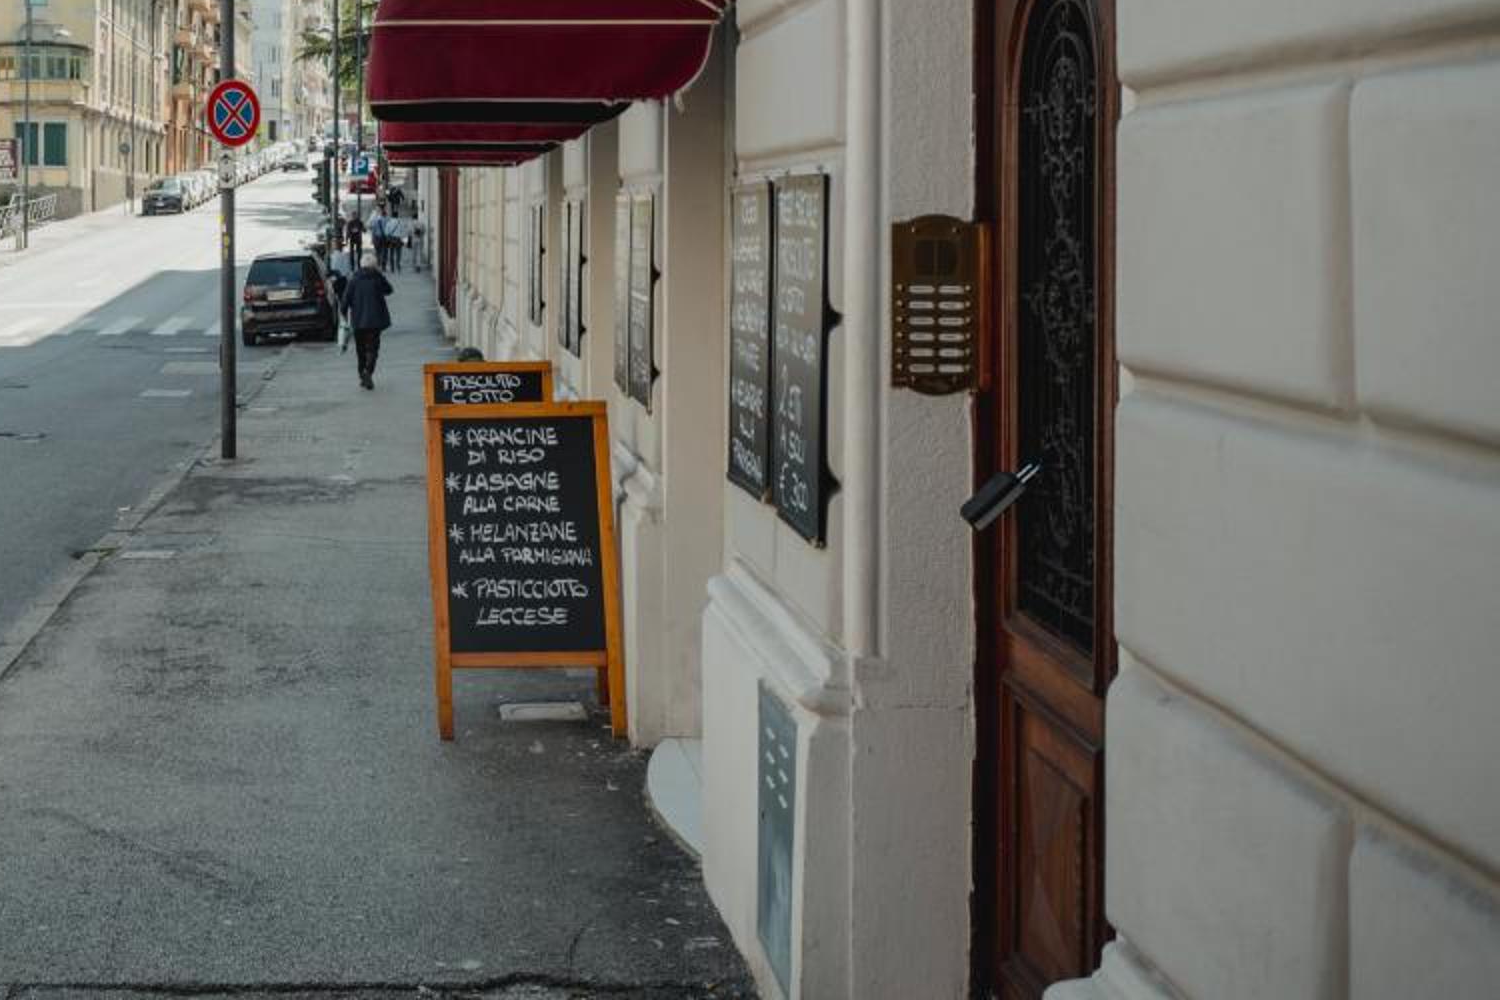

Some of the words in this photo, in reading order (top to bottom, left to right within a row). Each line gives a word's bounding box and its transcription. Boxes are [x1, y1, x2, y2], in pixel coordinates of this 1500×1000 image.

[451, 389, 514, 404] COTTO
[465, 427, 559, 447] ARANCINE
[467, 450, 486, 466] DI
[497, 447, 545, 464] RISO
[464, 471, 561, 492] LASAGNE
[463, 495, 497, 516] ALLA
[502, 495, 561, 514] CARNE
[459, 546, 496, 566] ALLA
[471, 578, 589, 599] PASTICCIOTTO
[476, 606, 569, 626] LECCESE
